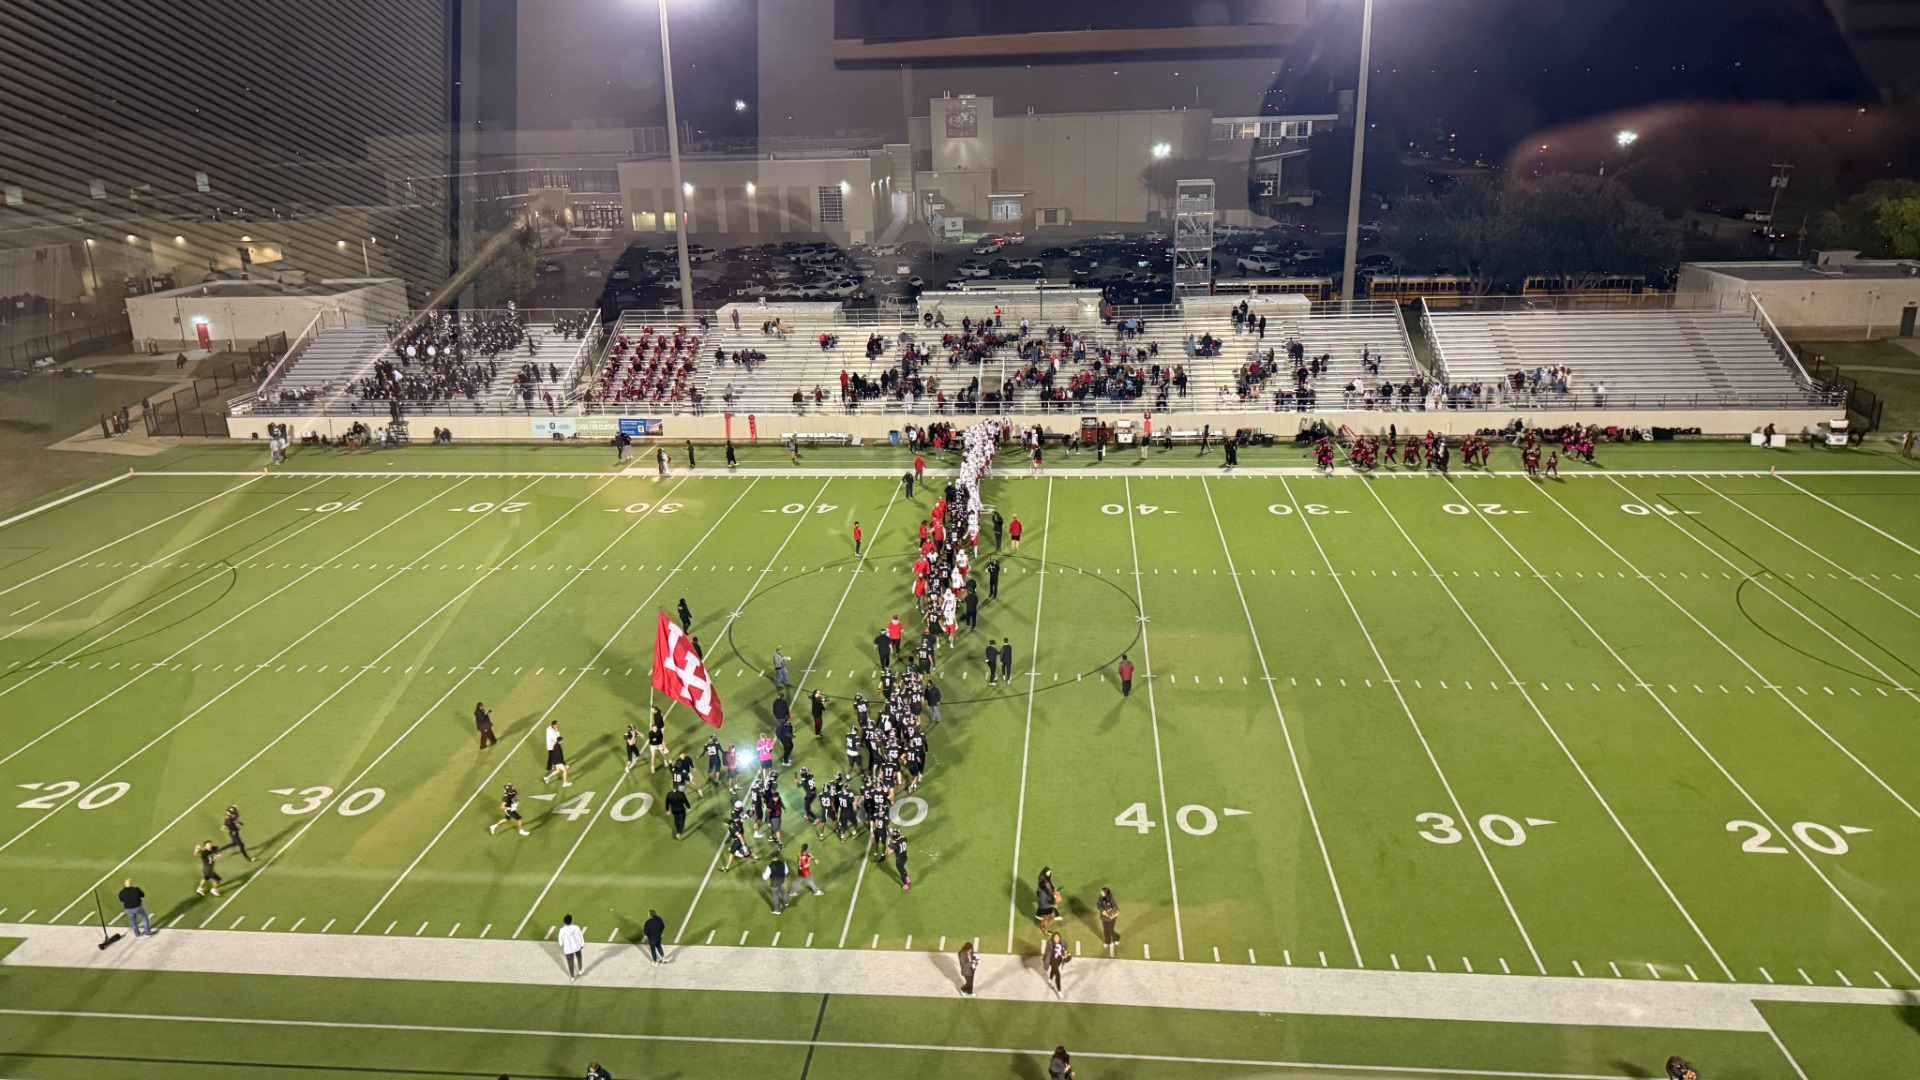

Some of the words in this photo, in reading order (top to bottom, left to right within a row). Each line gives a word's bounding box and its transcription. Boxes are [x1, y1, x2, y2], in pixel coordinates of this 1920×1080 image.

[467, 502, 531, 514] 20
[625, 502, 684, 514] 30
[781, 503, 839, 515] 40
[1100, 503, 1160, 515] 40
[1268, 503, 1330, 515] 30
[1442, 503, 1510, 516] 20
[673, 773, 682, 783] 18
[885, 767, 894, 777] 17
[17, 780, 131, 810] 20
[280, 786, 386, 816] 30
[553, 791, 655, 822] 40
[1114, 802, 1218, 836] 40
[1415, 812, 1527, 846] 30
[1725, 820, 1849, 855] 20
